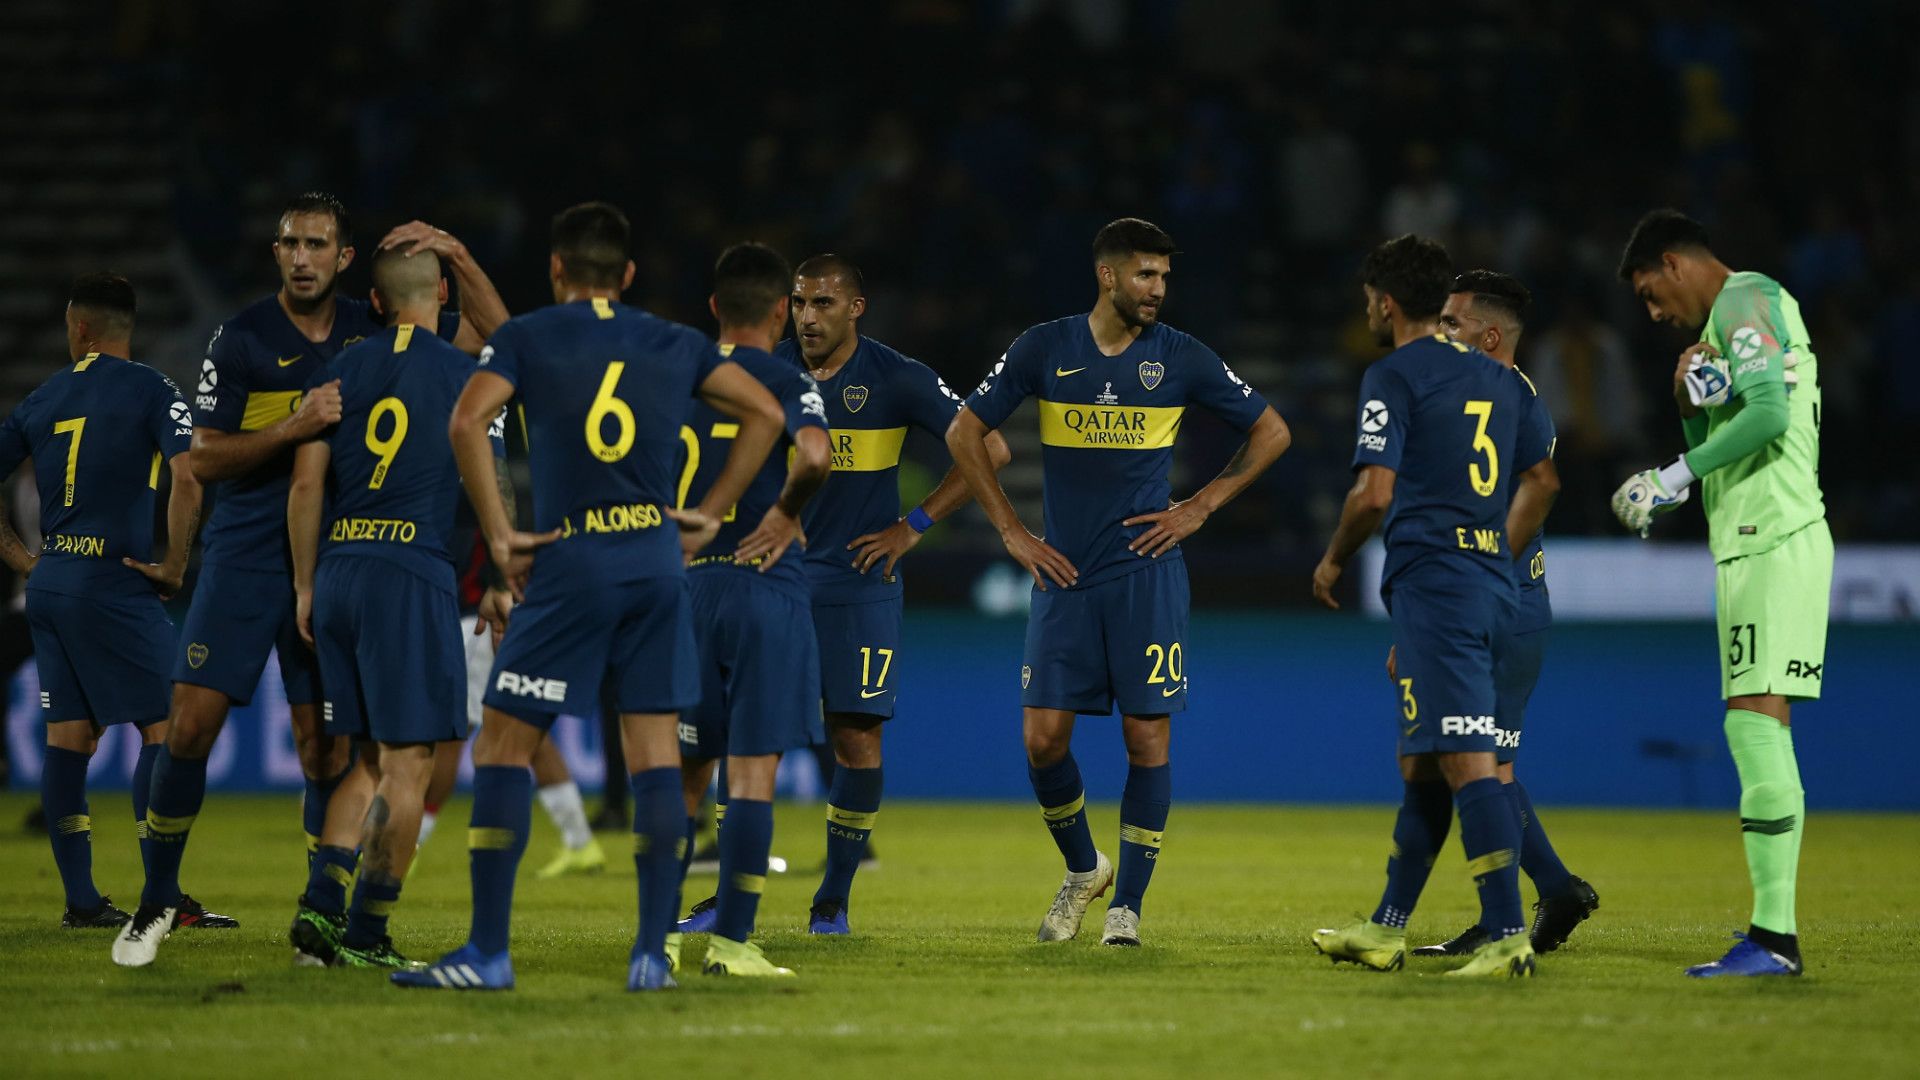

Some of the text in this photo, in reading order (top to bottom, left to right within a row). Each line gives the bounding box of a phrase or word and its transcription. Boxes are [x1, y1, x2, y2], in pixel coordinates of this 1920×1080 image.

[584, 360, 637, 464] 6
[1064, 409, 1147, 433] QATAR
[365, 396, 409, 490] 9
[1083, 432, 1145, 445] AIRWAYS
[1463, 400, 1500, 497] 3
[53, 416, 87, 507] 7
[328, 517, 417, 544] ENEDETTO
[584, 503, 663, 534] ALONSO
[54, 534, 105, 558] PAVON
[1145, 642, 1183, 684] 20
[1729, 624, 1756, 666] 31
[496, 669, 568, 703] AXE
[859, 646, 894, 688] 17
[1785, 660, 1822, 680] AX
[1399, 678, 1418, 721] 3
[1441, 715, 1497, 736] AXE
